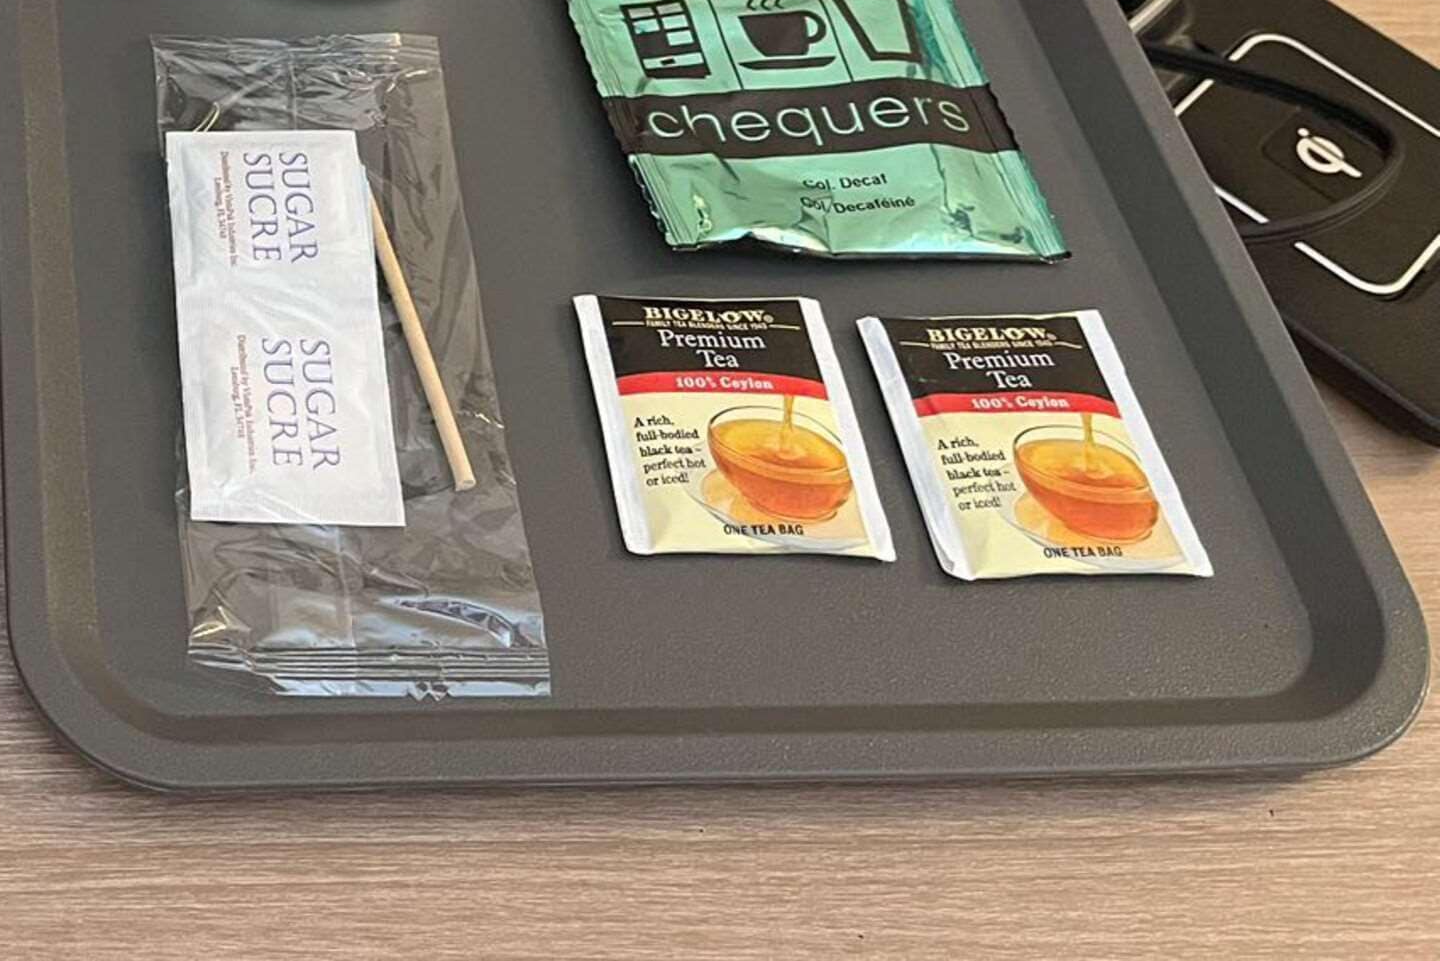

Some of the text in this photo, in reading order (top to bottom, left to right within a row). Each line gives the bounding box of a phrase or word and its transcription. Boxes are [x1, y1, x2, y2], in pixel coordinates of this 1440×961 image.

[647, 96, 969, 146] chequers
[839, 173, 888, 188] Decaf
[243, 152, 281, 261] SUCRE
[279, 151, 318, 263] SUGAR
[657, 330, 766, 349] Premium
[696, 349, 739, 369] Tea
[944, 350, 1056, 369] Premium
[676, 376, 773, 390] 100% Ceylon
[987, 370, 1031, 389] Tea
[262, 338, 303, 466] SUCRE
[301, 339, 341, 469] SUGAR
[1015, 396, 1070, 410] Ceylon
[634, 417, 644, 428] A
[637, 429, 700, 442] full-bodied
[639, 444, 672, 457] black
[937, 439, 948, 450] A
[643, 458, 706, 474] perfect hot
[946, 467, 981, 480] black
[646, 477, 659, 486] or
[953, 481, 995, 497] perfect
[958, 501, 971, 511] or
[723, 524, 804, 536] ONE TEA BAG
[1044, 546, 1123, 558] ONE TEA BAG
